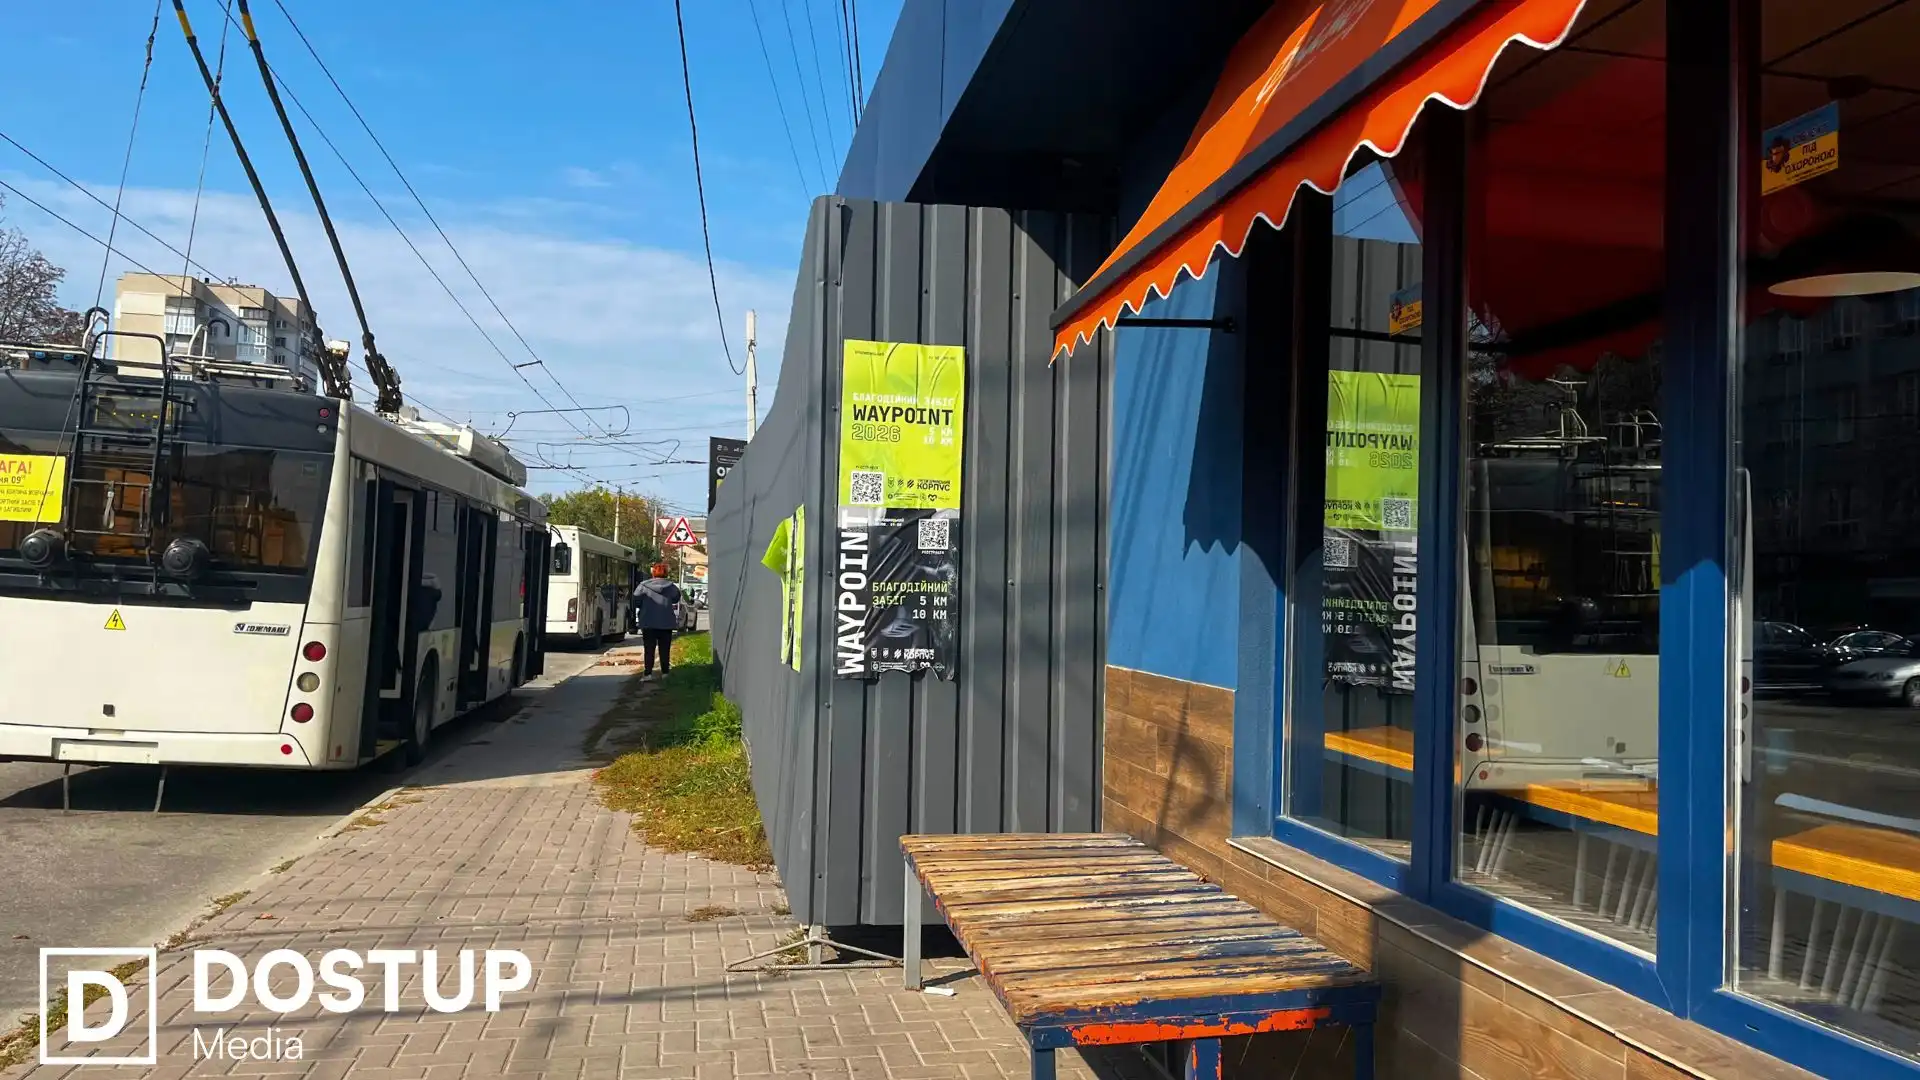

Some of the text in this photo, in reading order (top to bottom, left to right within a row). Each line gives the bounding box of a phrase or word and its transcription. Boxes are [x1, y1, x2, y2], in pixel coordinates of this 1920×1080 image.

[853, 404, 953, 425] WAYPOINT
[852, 423, 900, 442] 2026
[917, 483, 950, 492] КОРПУС
[837, 509, 869, 675] WAYPOINT
[872, 580, 948, 593] БЛАГОДІЙНИЙ
[872, 595, 948, 606] ЗАБІГ 5 КМ
[912, 609, 947, 620] 10 КМ
